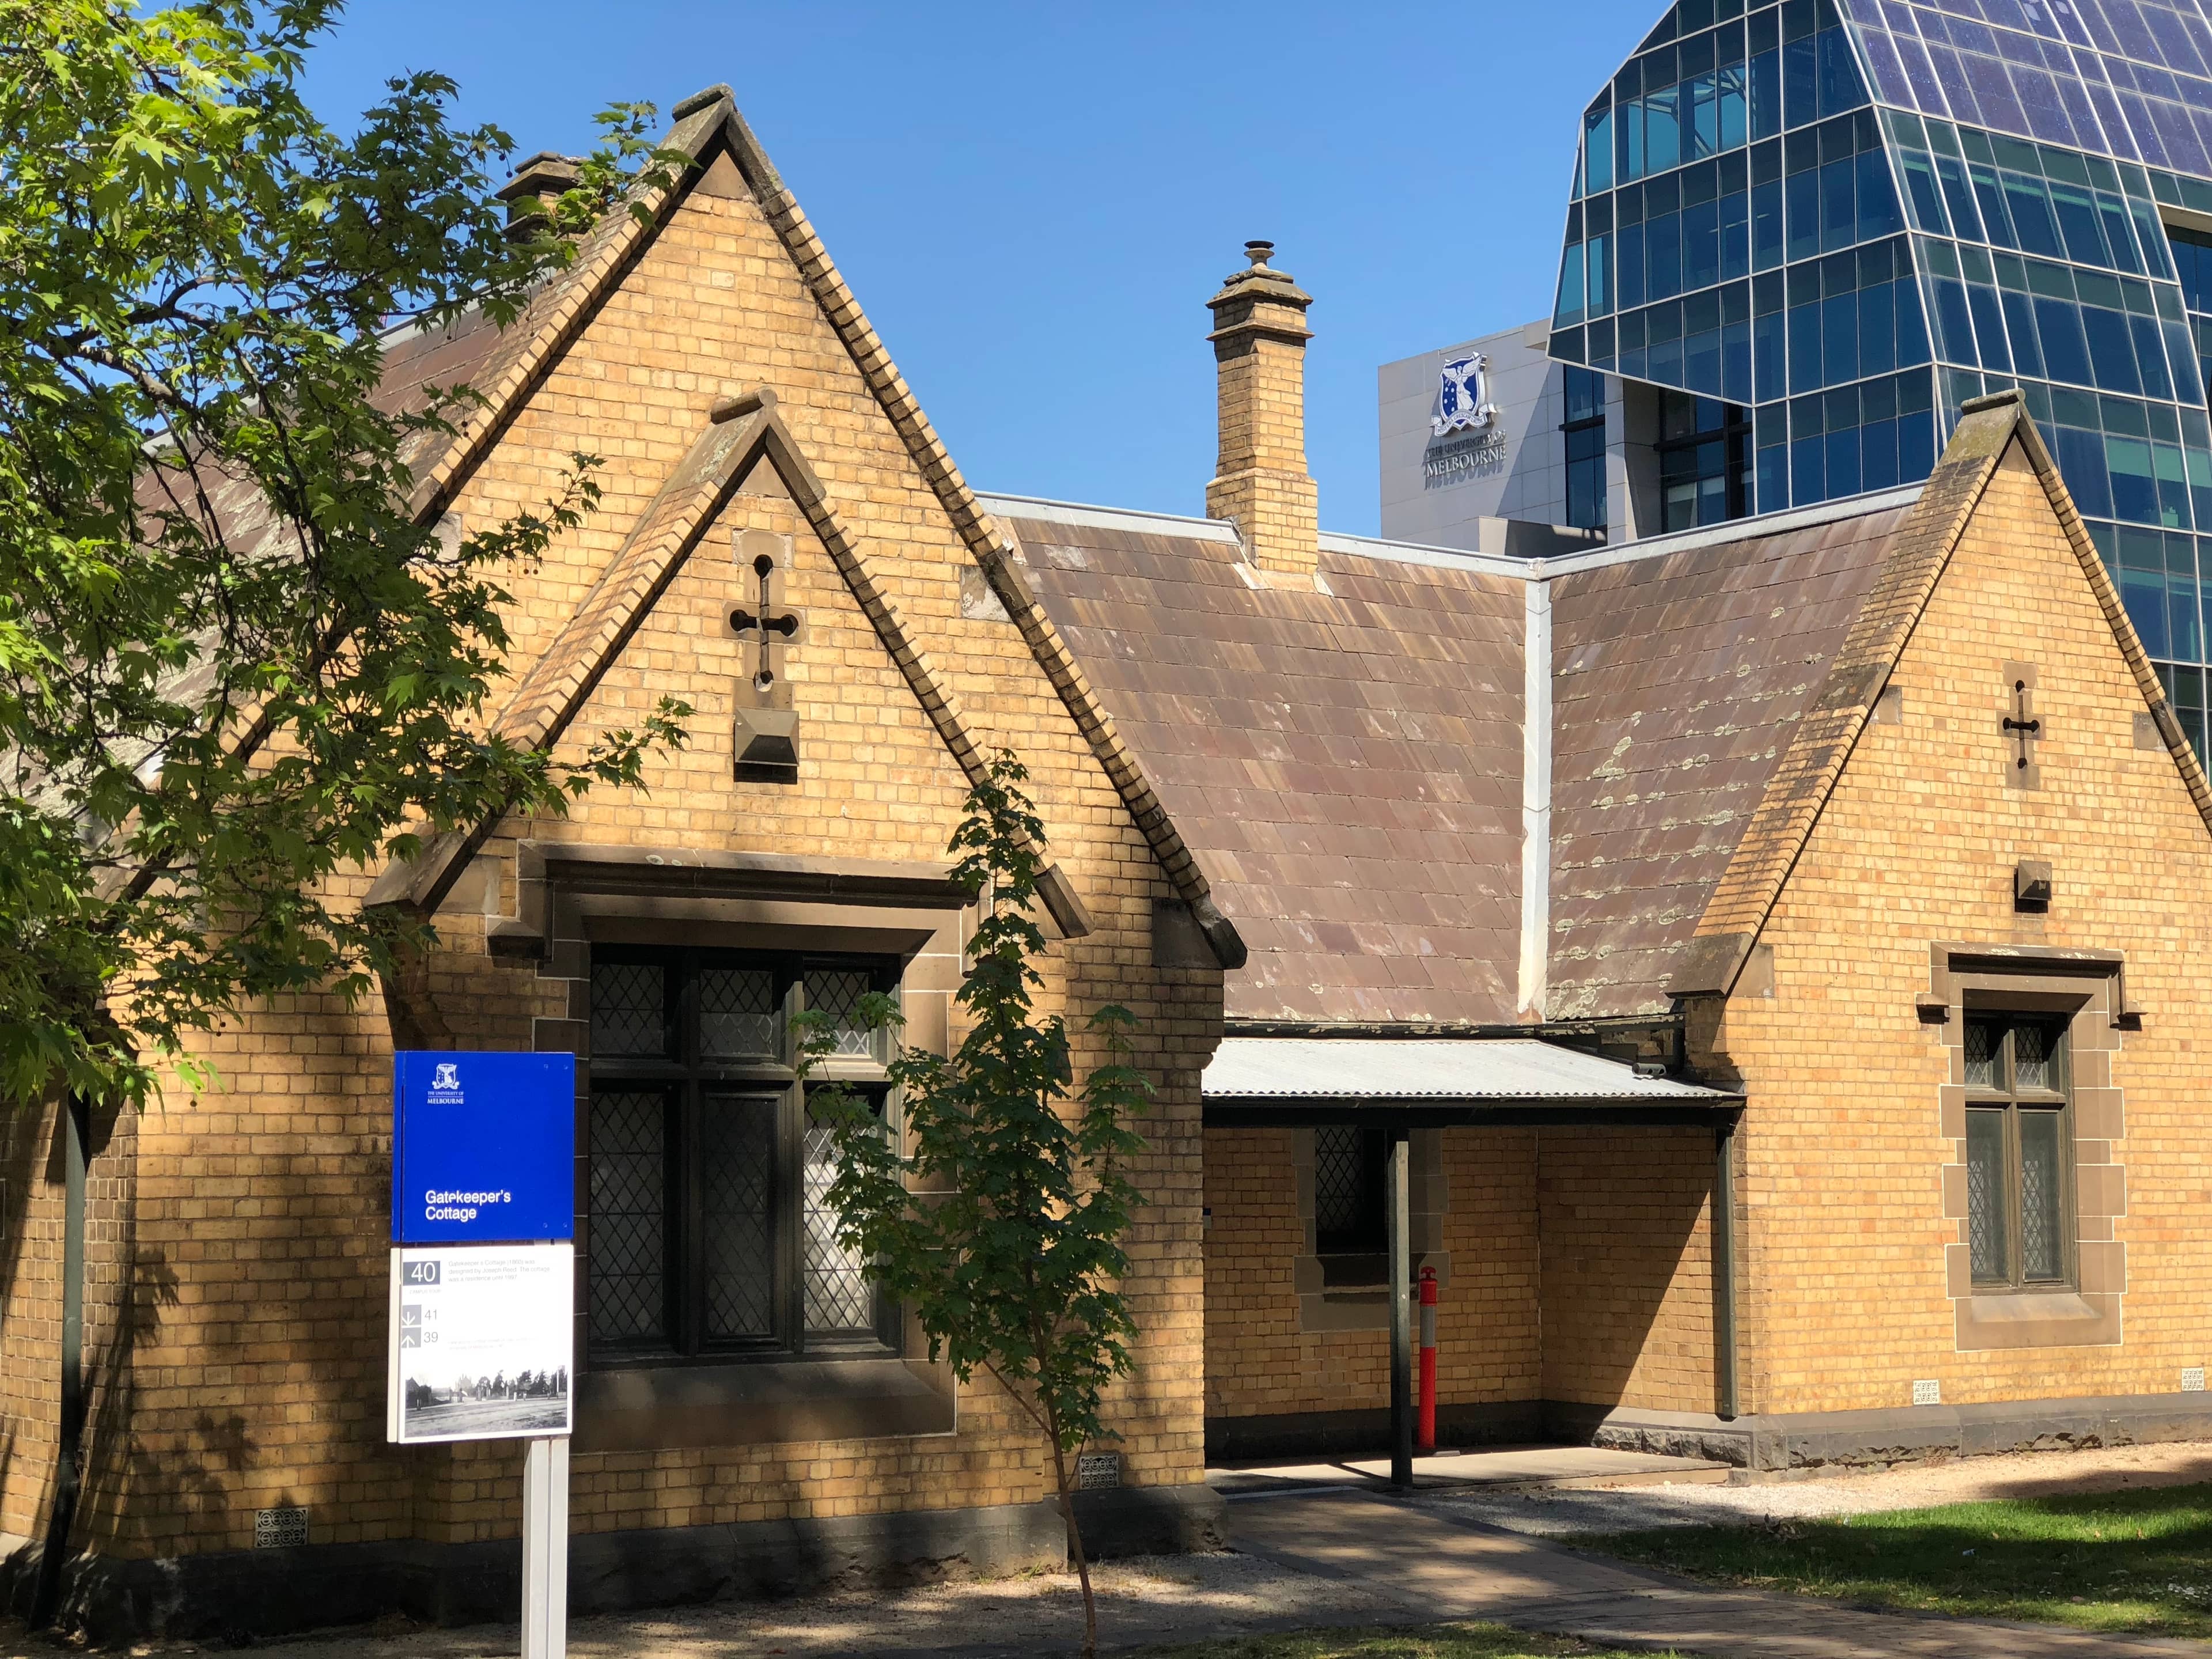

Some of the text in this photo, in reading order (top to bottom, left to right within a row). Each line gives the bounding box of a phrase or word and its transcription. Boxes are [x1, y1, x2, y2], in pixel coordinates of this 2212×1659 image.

[1427, 445, 1506, 478] MELBOURNE
[425, 1189, 511, 1206] Gatekeeper's
[425, 1206, 477, 1222] Cottage
[411, 1262, 435, 1282] 40
[425, 1309, 437, 1320] 41
[424, 1331, 438, 1343] 39
